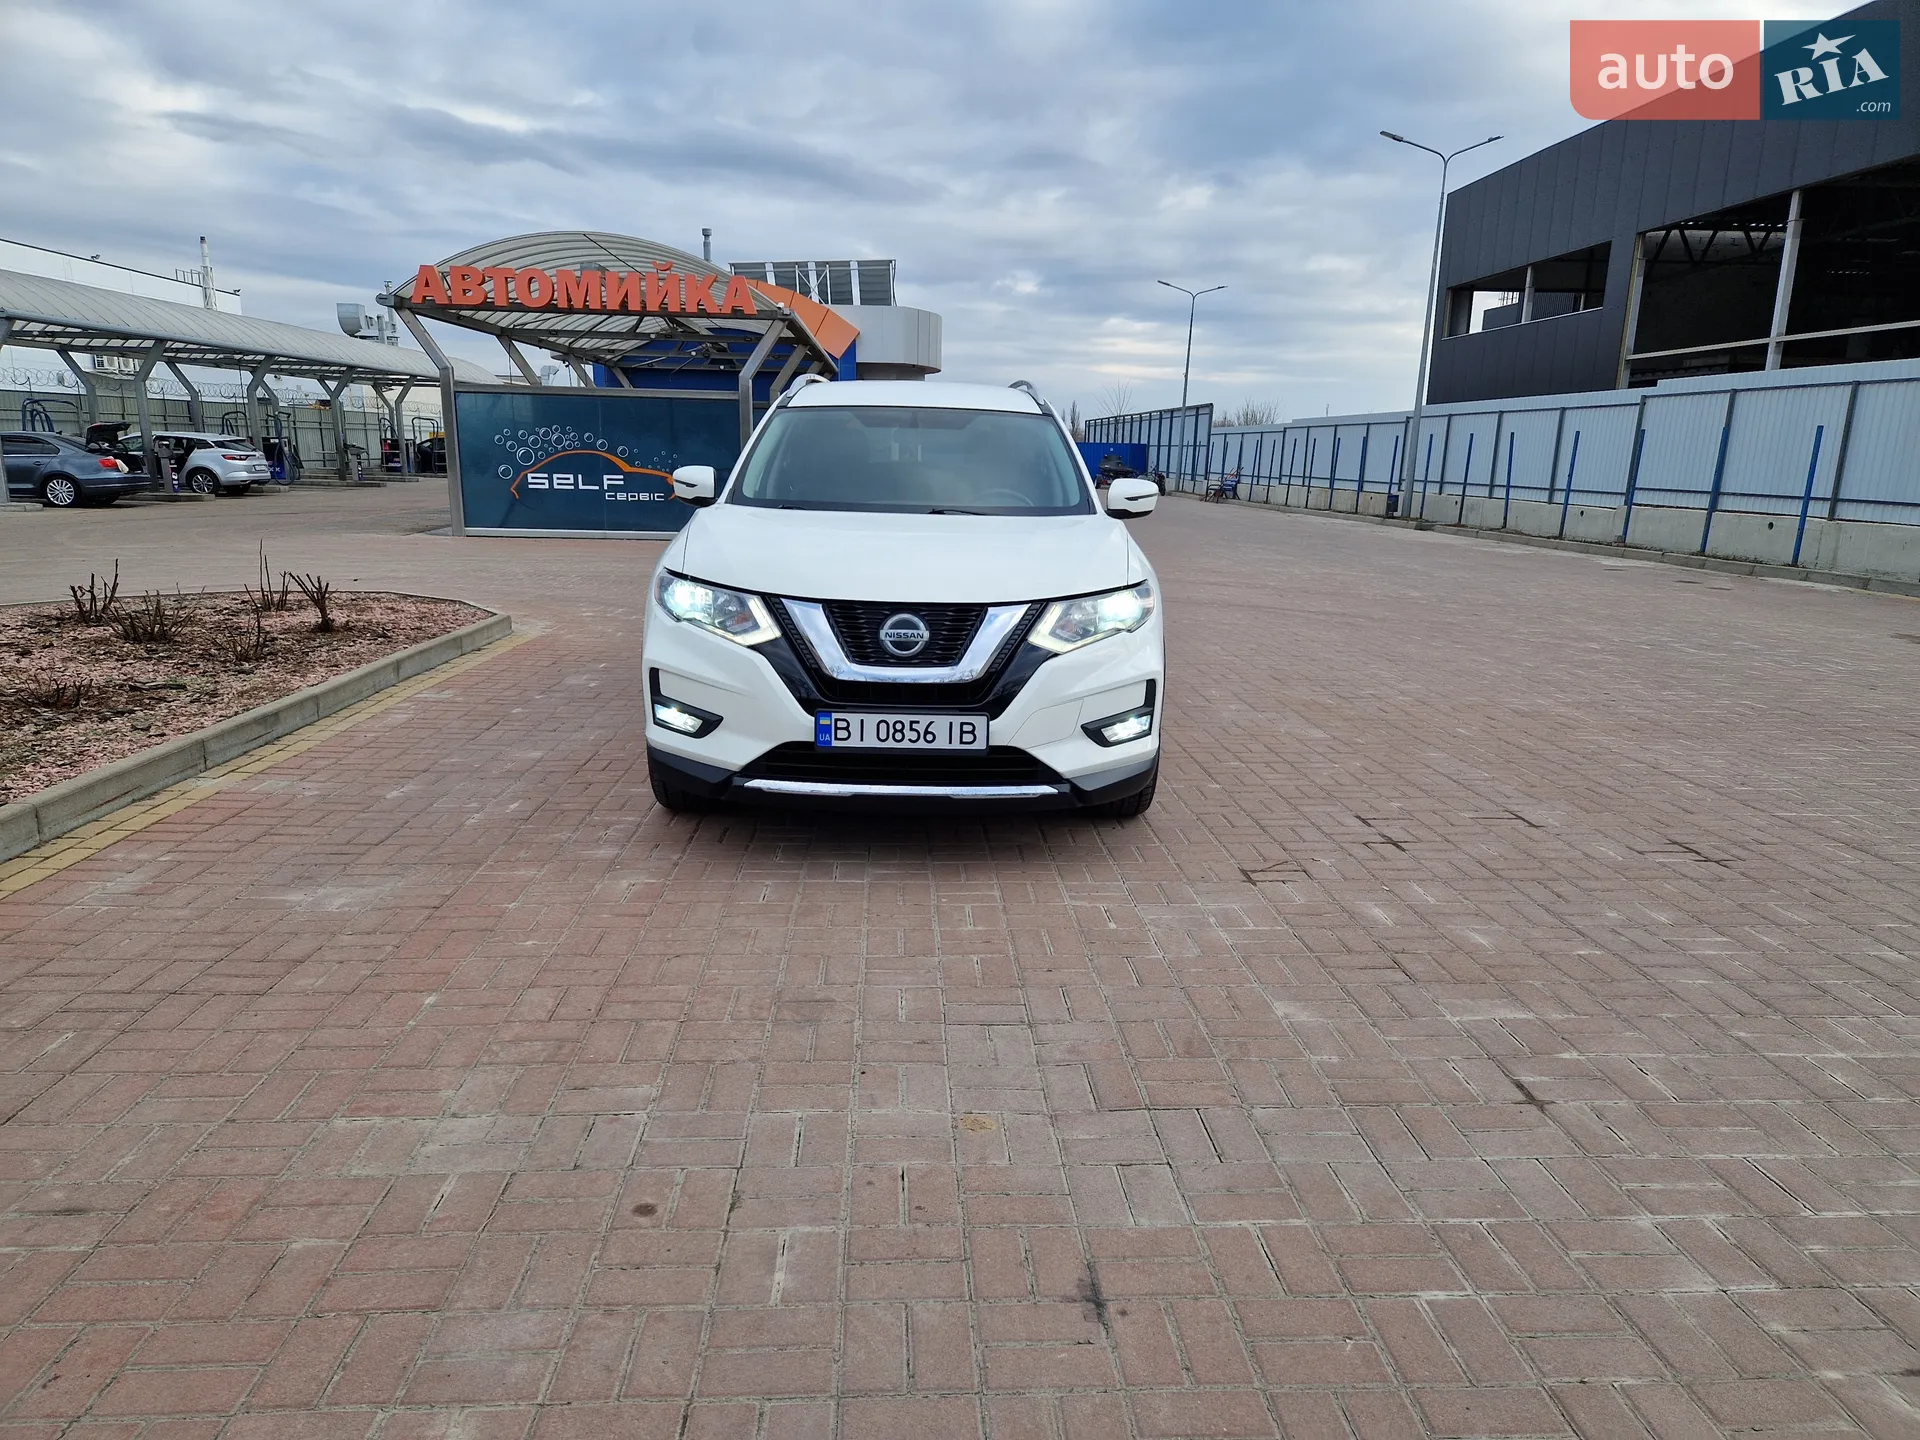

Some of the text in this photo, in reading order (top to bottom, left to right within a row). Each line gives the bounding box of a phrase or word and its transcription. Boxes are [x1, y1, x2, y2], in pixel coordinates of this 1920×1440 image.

[411, 261, 758, 315] АВТОМИЙКА
[884, 631, 924, 640] NISSAN
[819, 733, 831, 742] UA
[834, 718, 977, 745] BI 0856 IB
